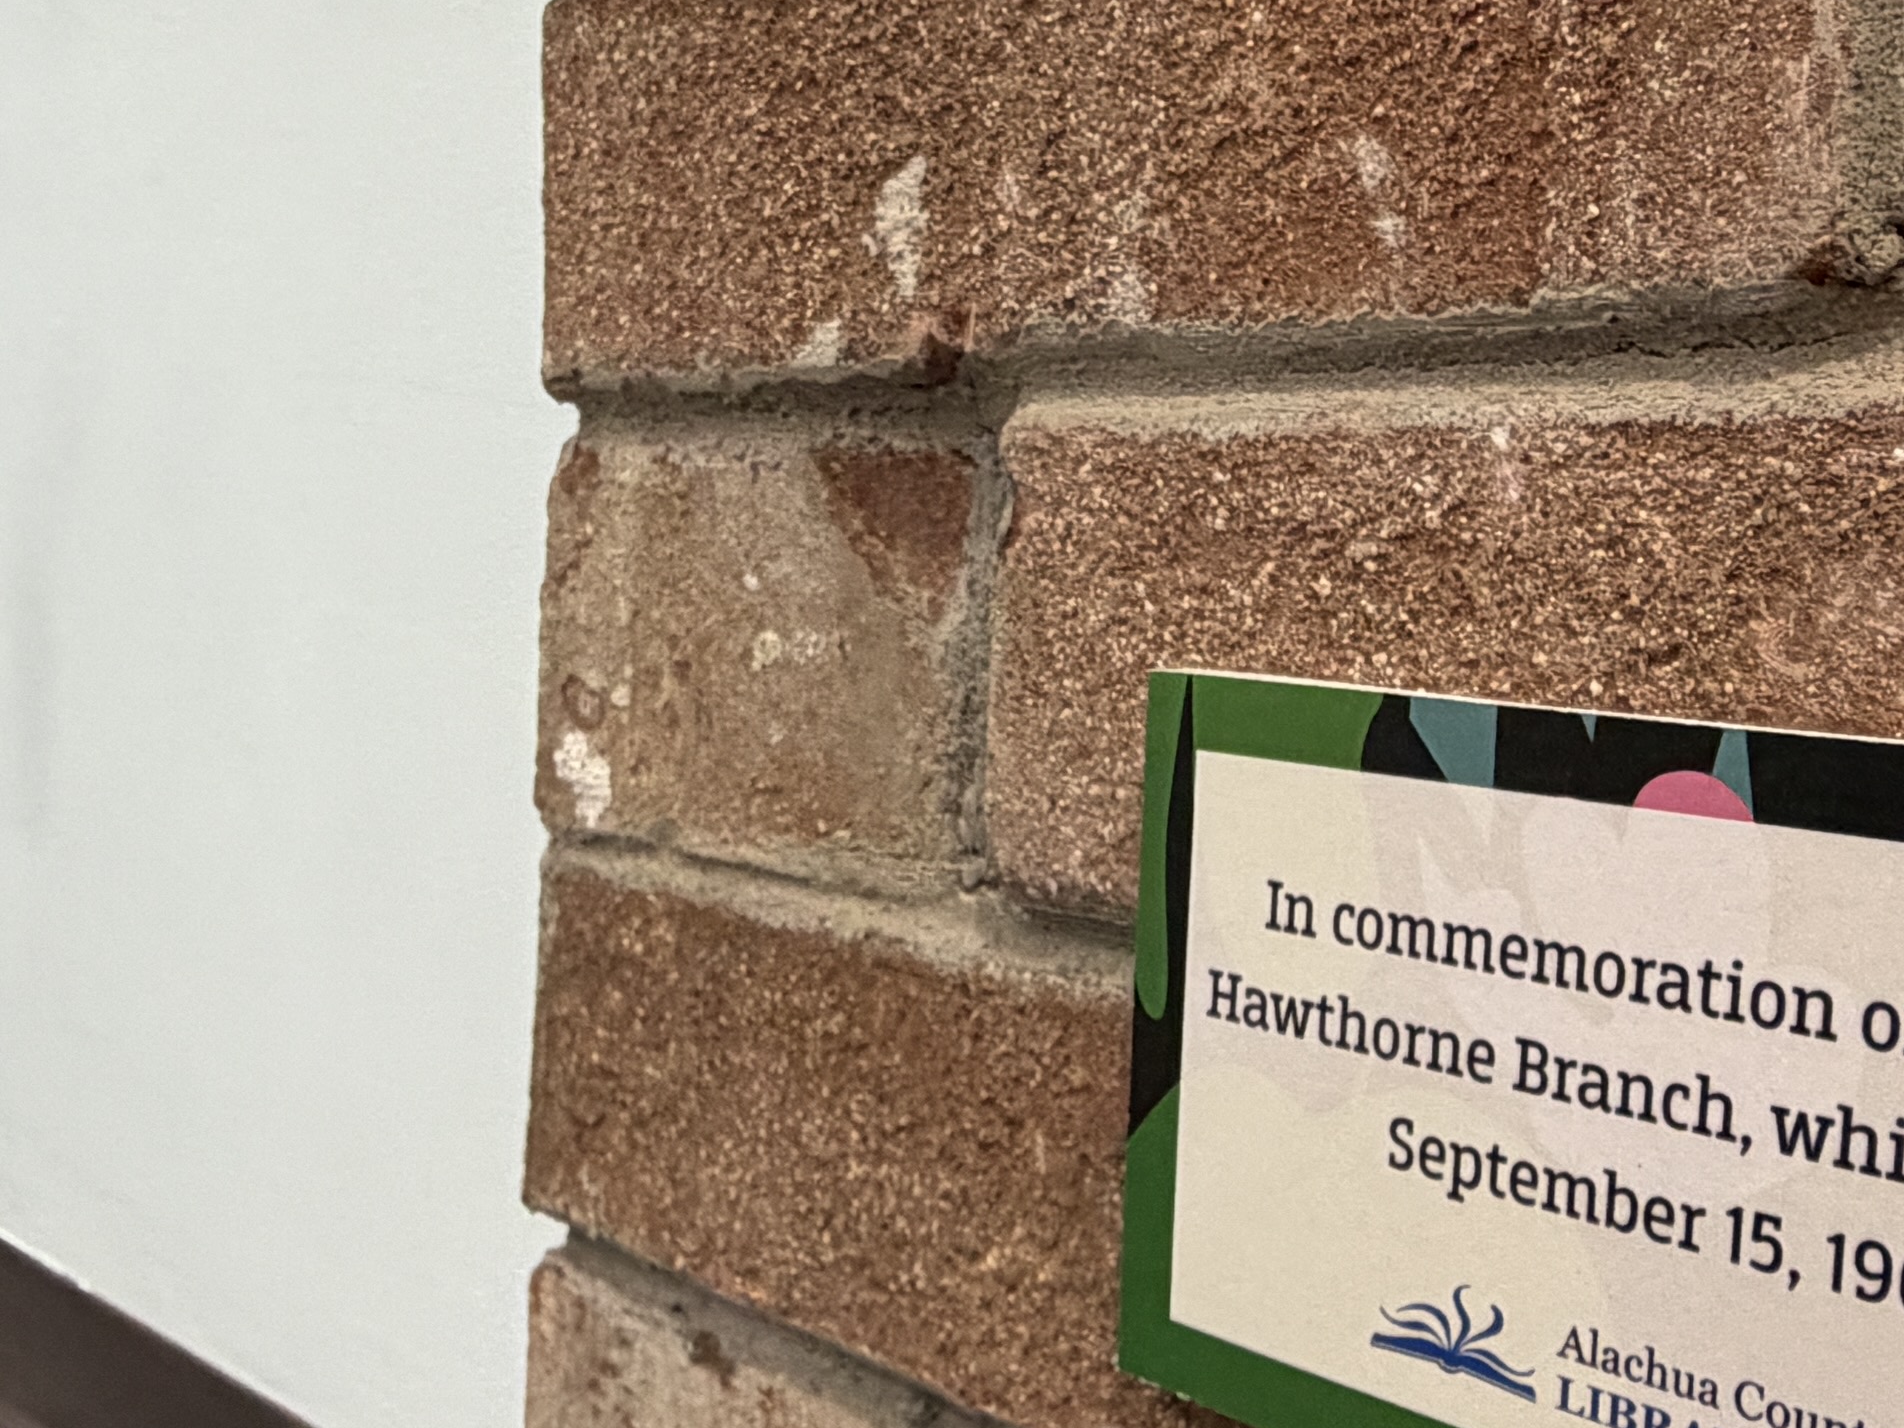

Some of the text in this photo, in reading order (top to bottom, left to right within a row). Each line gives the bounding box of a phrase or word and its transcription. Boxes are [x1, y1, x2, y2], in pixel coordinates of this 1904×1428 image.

[1263, 878, 1318, 940] In
[1331, 901, 1839, 1044] commemoration
[1204, 967, 1497, 1086] Hawthorne
[1510, 1035, 1754, 1158] Branch,
[1387, 1115, 1708, 1255] September
[1724, 1204, 1803, 1293] 15,
[1554, 1324, 1721, 1412] Alachua
